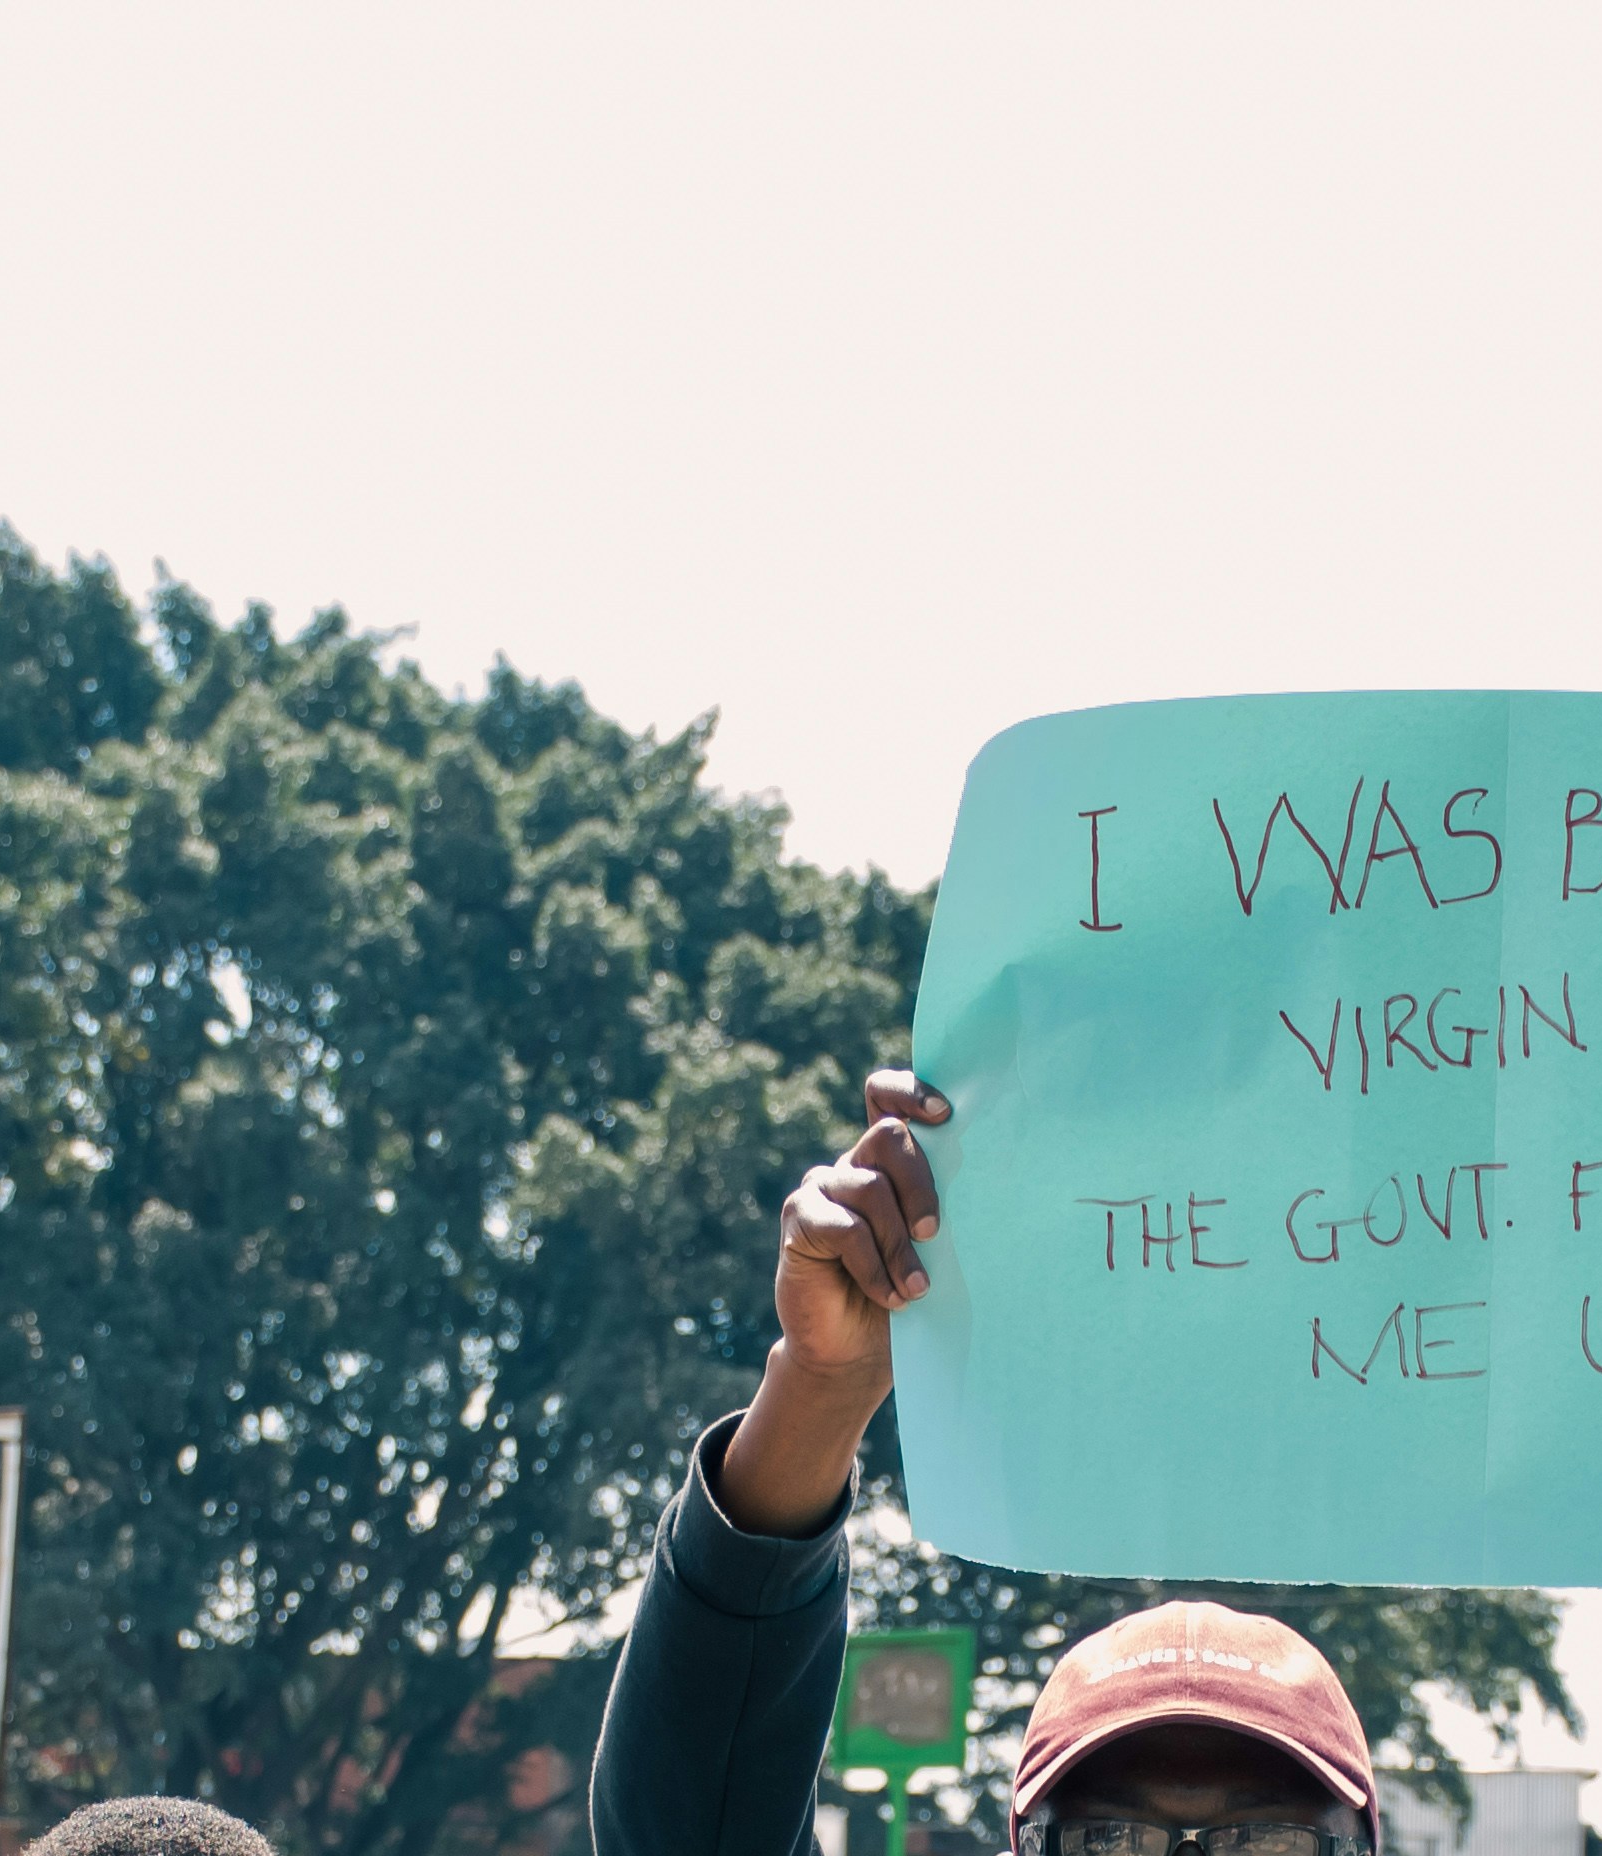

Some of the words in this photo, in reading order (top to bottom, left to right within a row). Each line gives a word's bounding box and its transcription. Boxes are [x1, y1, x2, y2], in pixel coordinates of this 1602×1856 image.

[1076, 804, 1125, 934] I
[1211, 773, 1504, 919] WAS
[1075, 1190, 1250, 1274] THE
[1284, 1161, 1510, 1265] GOVT.
[1309, 1300, 1488, 1387] ME
